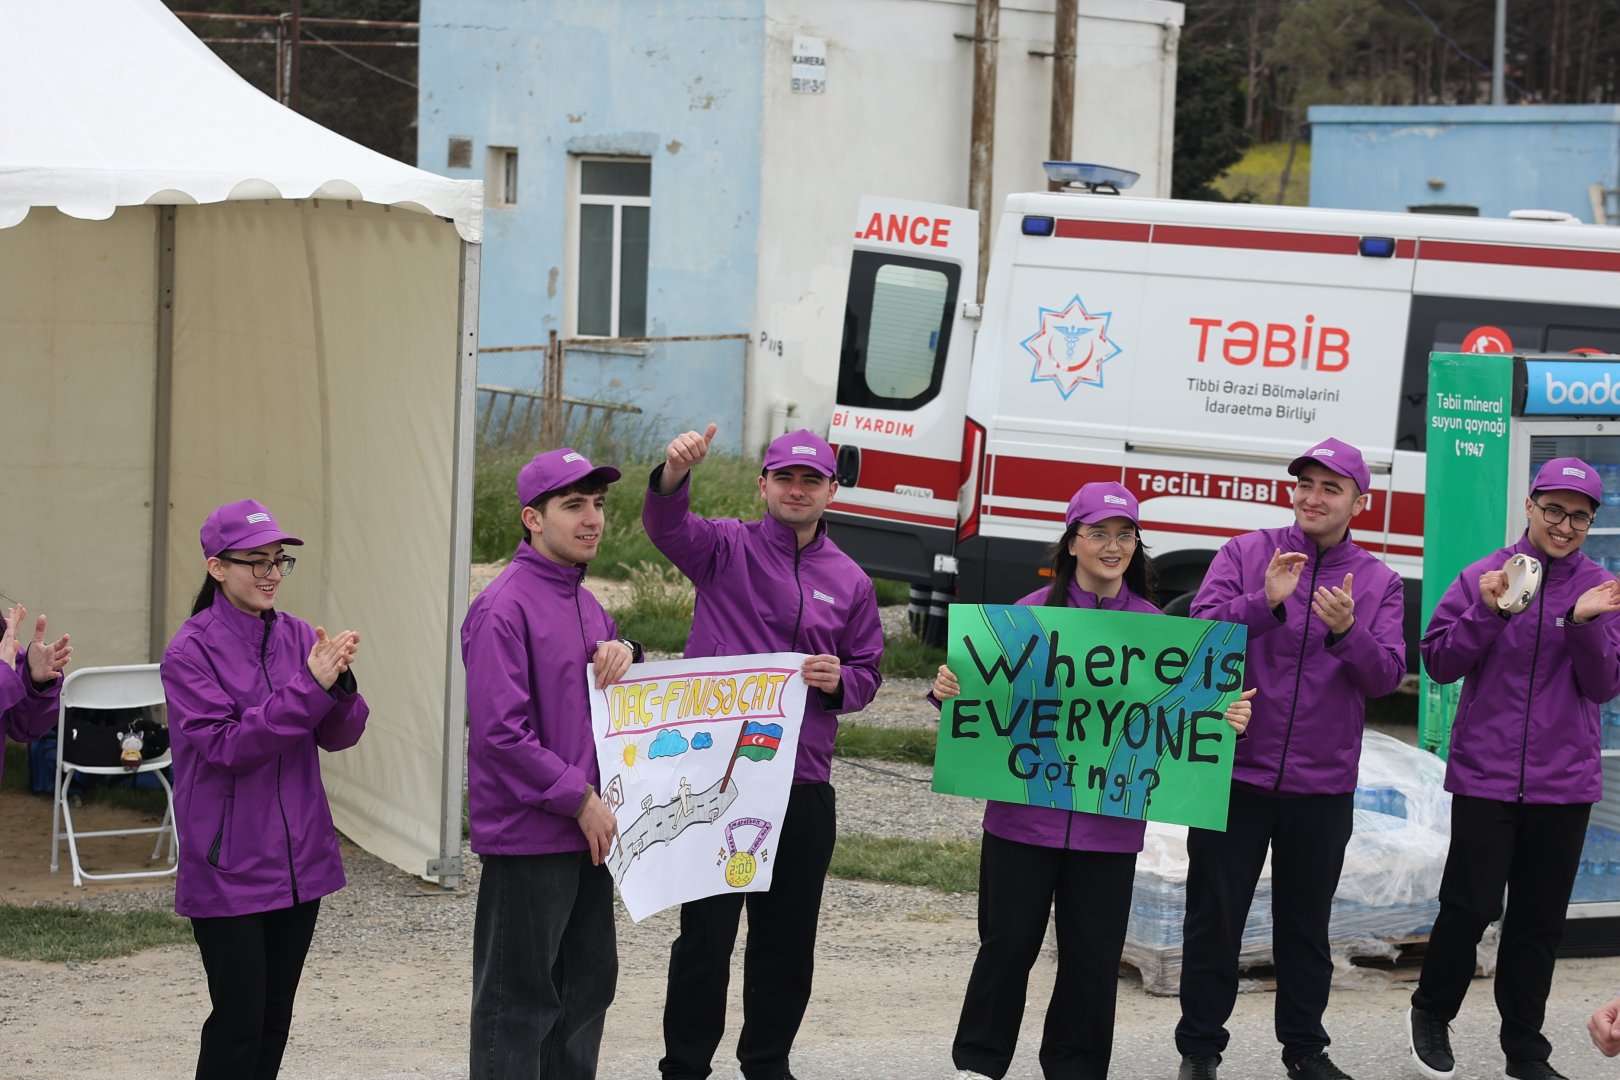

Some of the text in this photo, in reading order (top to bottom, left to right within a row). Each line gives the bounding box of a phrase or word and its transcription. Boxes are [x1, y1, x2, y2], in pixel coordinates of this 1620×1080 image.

[854, 212, 951, 248] ANCE
[1189, 314, 1350, 372] TƏBİB
[1223, 380, 1258, 396] Ərazi
[1262, 383, 1340, 402] Bölmələrini
[1437, 393, 1503, 414] Təbii mineral
[1205, 397, 1316, 423] İdarəetmə Birliyi
[855, 415, 916, 437] YARDIM
[1432, 416, 1506, 437] suyun qaynağı
[1138, 473, 1210, 497] TƏCİLİ
[1218, 476, 1277, 502] TİBBİ
[963, 631, 1245, 692] Where is
[951, 698, 1224, 764] EVERYONE
[1008, 743, 1160, 806] Going?
